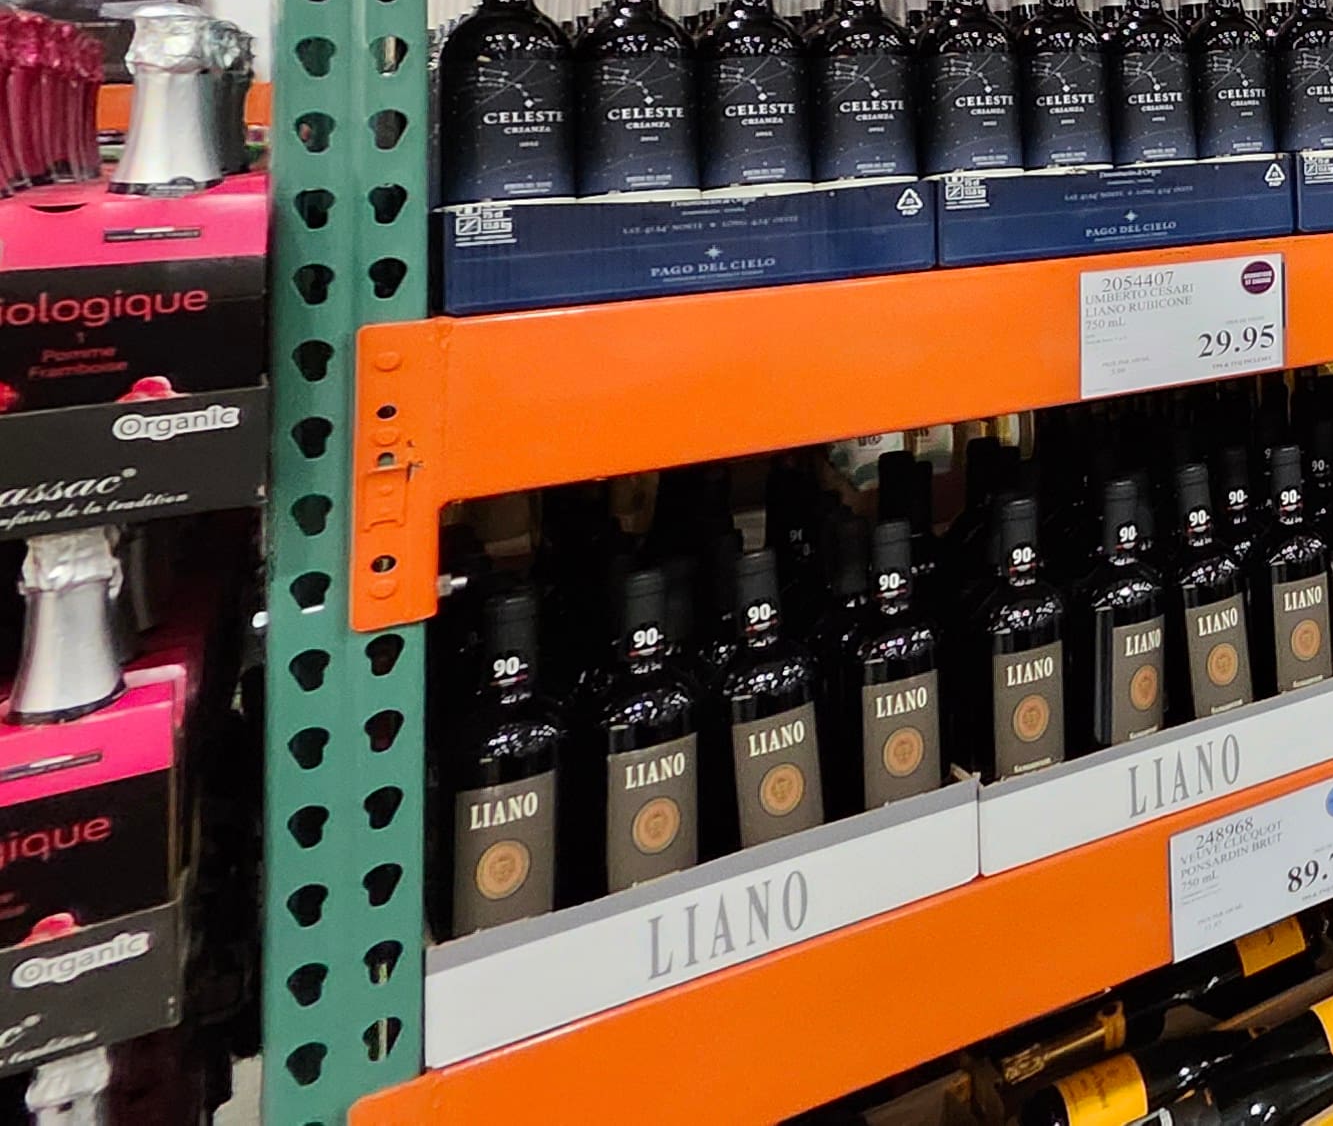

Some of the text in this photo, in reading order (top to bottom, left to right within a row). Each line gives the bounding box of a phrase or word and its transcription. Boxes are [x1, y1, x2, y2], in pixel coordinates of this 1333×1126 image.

[725, 103, 796, 117] CELESTE
[839, 99, 904, 113] CELESTE
[1036, 93, 1094, 107] CELESTE
[1128, 92, 1183, 105] CELESTE
[483, 110, 564, 124] CELESTE
[607, 106, 685, 121] CELESTE
[504, 126, 551, 134] CRIANZA
[1085, 221, 1177, 237] PAGO DEL CIELO
[651, 257, 776, 277] PAGO DEL CIELO
[1084, 282, 1195, 305] UMBERTO CESARI
[1102, 271, 1174, 293] 2054407
[0, 289, 209, 327] iologique
[1085, 295, 1193, 318] LIANO RUBICONE
[1085, 316, 1126, 330] 750 mL
[41, 346, 116, 363] Pomme
[1198, 323, 1276, 358] 29.95
[28, 361, 128, 378] Framboise
[118, 408, 239, 438] Organic
[0, 471, 122, 507] assac
[1284, 585, 1322, 612] LIANO
[1198, 607, 1239, 637] LIANO
[1125, 628, 1161, 657] LIANO
[1006, 656, 1054, 687] LIANO
[876, 686, 928, 719] LIANO
[748, 719, 805, 758] LIANO
[625, 752, 686, 790] LIANO
[1129, 733, 1241, 819] LIANO
[470, 792, 538, 831] LIANO
[1179, 819, 1282, 866] VEUVE CLICQUOT
[1196, 816, 1254, 850] 248968
[1180, 831, 1283, 879] PONSARDIN BRUT
[648, 870, 809, 980] LIANO
[23, 934, 150, 981] Organic
